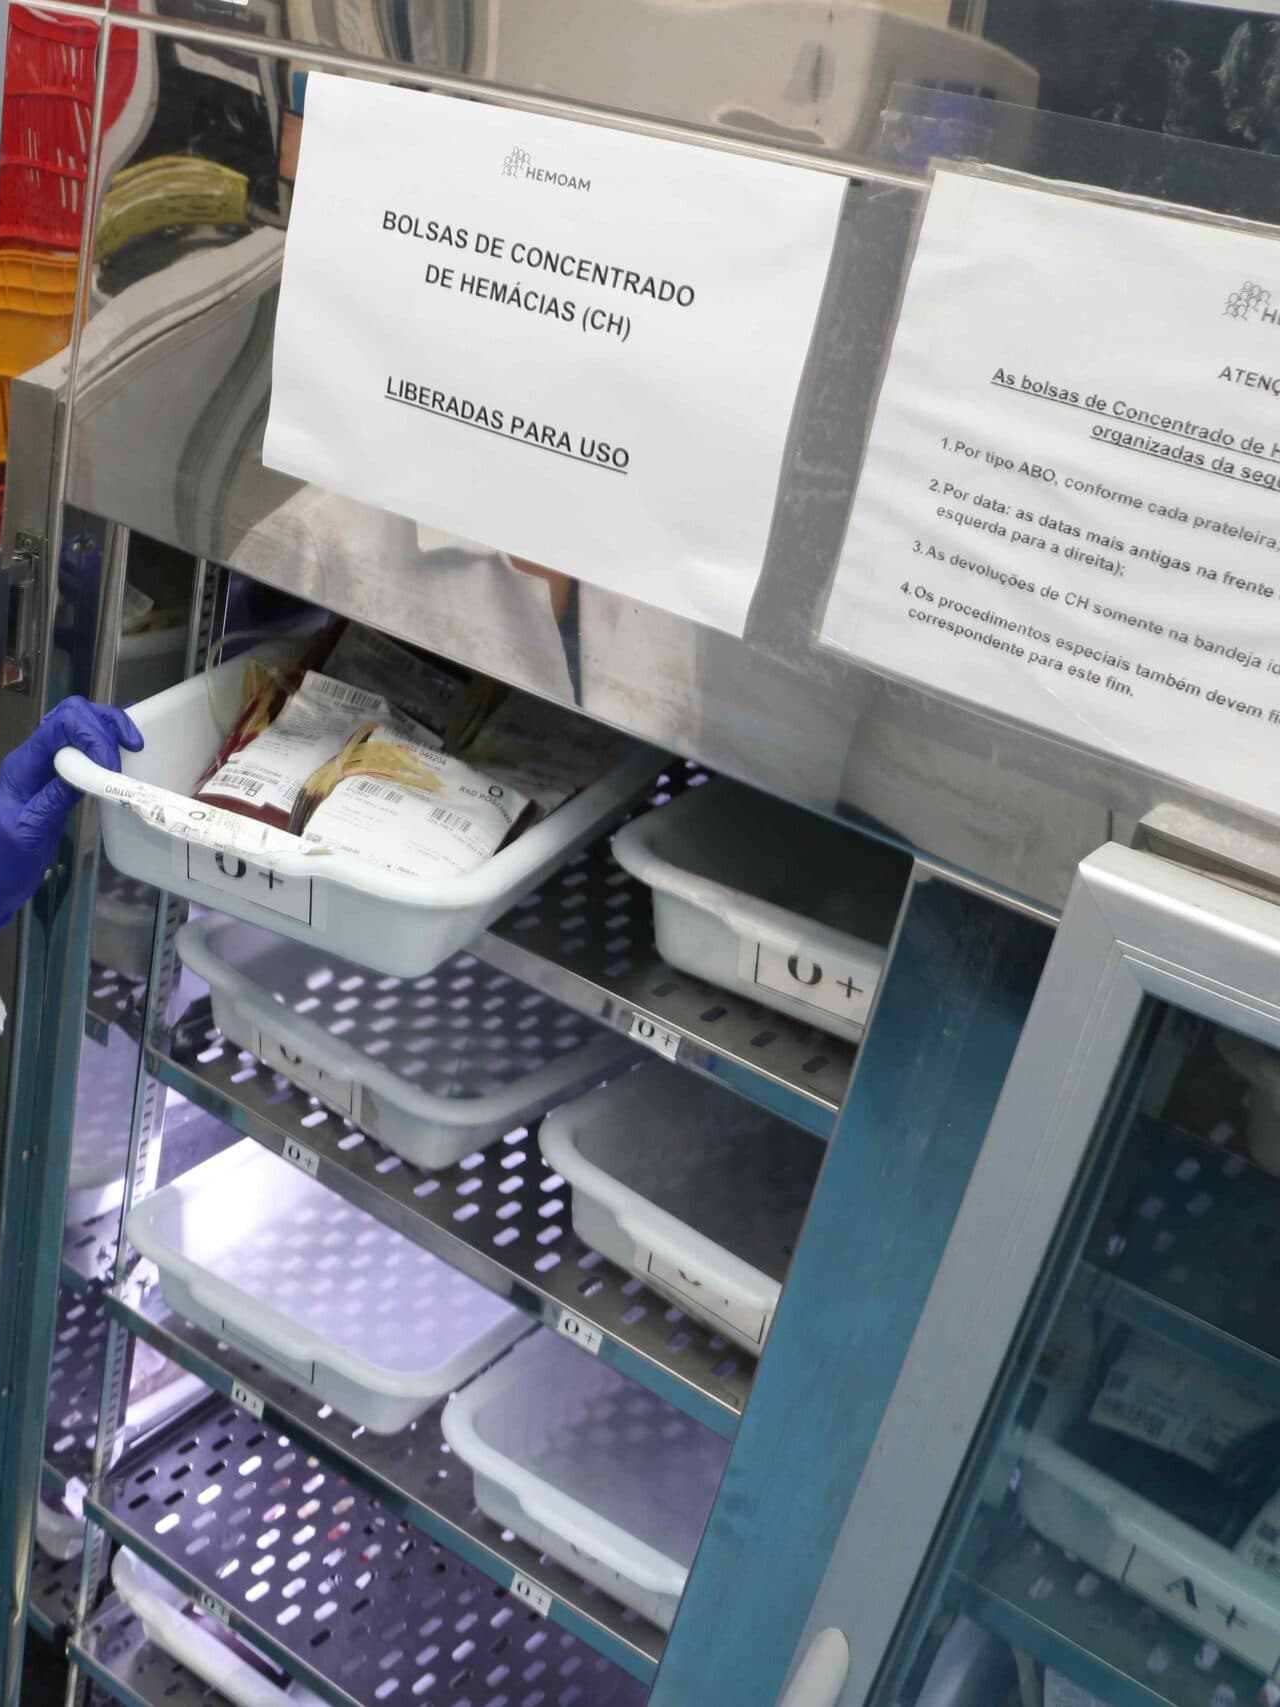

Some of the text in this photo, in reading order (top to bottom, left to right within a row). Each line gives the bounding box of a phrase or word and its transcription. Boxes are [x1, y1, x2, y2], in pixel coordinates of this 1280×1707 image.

[525, 167, 592, 193] HEMOAM
[382, 210, 695, 308] BOLSAS DE CONCENTRADO
[425, 264, 631, 343] DE HEMÁCIAS (CH)
[385, 376, 629, 469] LIBERADAS PARA USO
[992, 368, 1016, 386] As
[1021, 374, 1080, 404] bolsas
[1085, 394, 1107, 411] de
[1113, 400, 1235, 446] Concentrado
[1240, 437, 1265, 455] de
[1092, 425, 1205, 467] organizadas
[1211, 456, 1235, 475] da
[985, 451, 1015, 470] tipo
[1017, 461, 1059, 486] ABO,
[1064, 477, 1143, 509] conforme
[1147, 500, 1188, 523] cada
[936, 505, 1126, 577] esquerda para a direita);
[973, 494, 1012, 515] data:
[1015, 509, 1034, 522] as
[1038, 514, 1082, 538] datas
[1086, 529, 1124, 551] mais
[1128, 545, 1192, 573] antigas
[1196, 565, 1218, 581] na
[1222, 571, 1275, 599] frente
[908, 607, 1134, 697] correspondente para este fim.
[949, 554, 1036, 594] devoluções
[1039, 585, 1060, 601] de
[1064, 592, 1089, 610] CH
[1092, 603, 1164, 635] somente
[1168, 629, 1189, 644] na
[1193, 634, 1262, 668] bandeja
[938, 595, 1052, 644] procedimentos
[1055, 637, 1131, 672] especiais
[1135, 663, 1201, 697] também
[1205, 689, 1263, 719] devem
